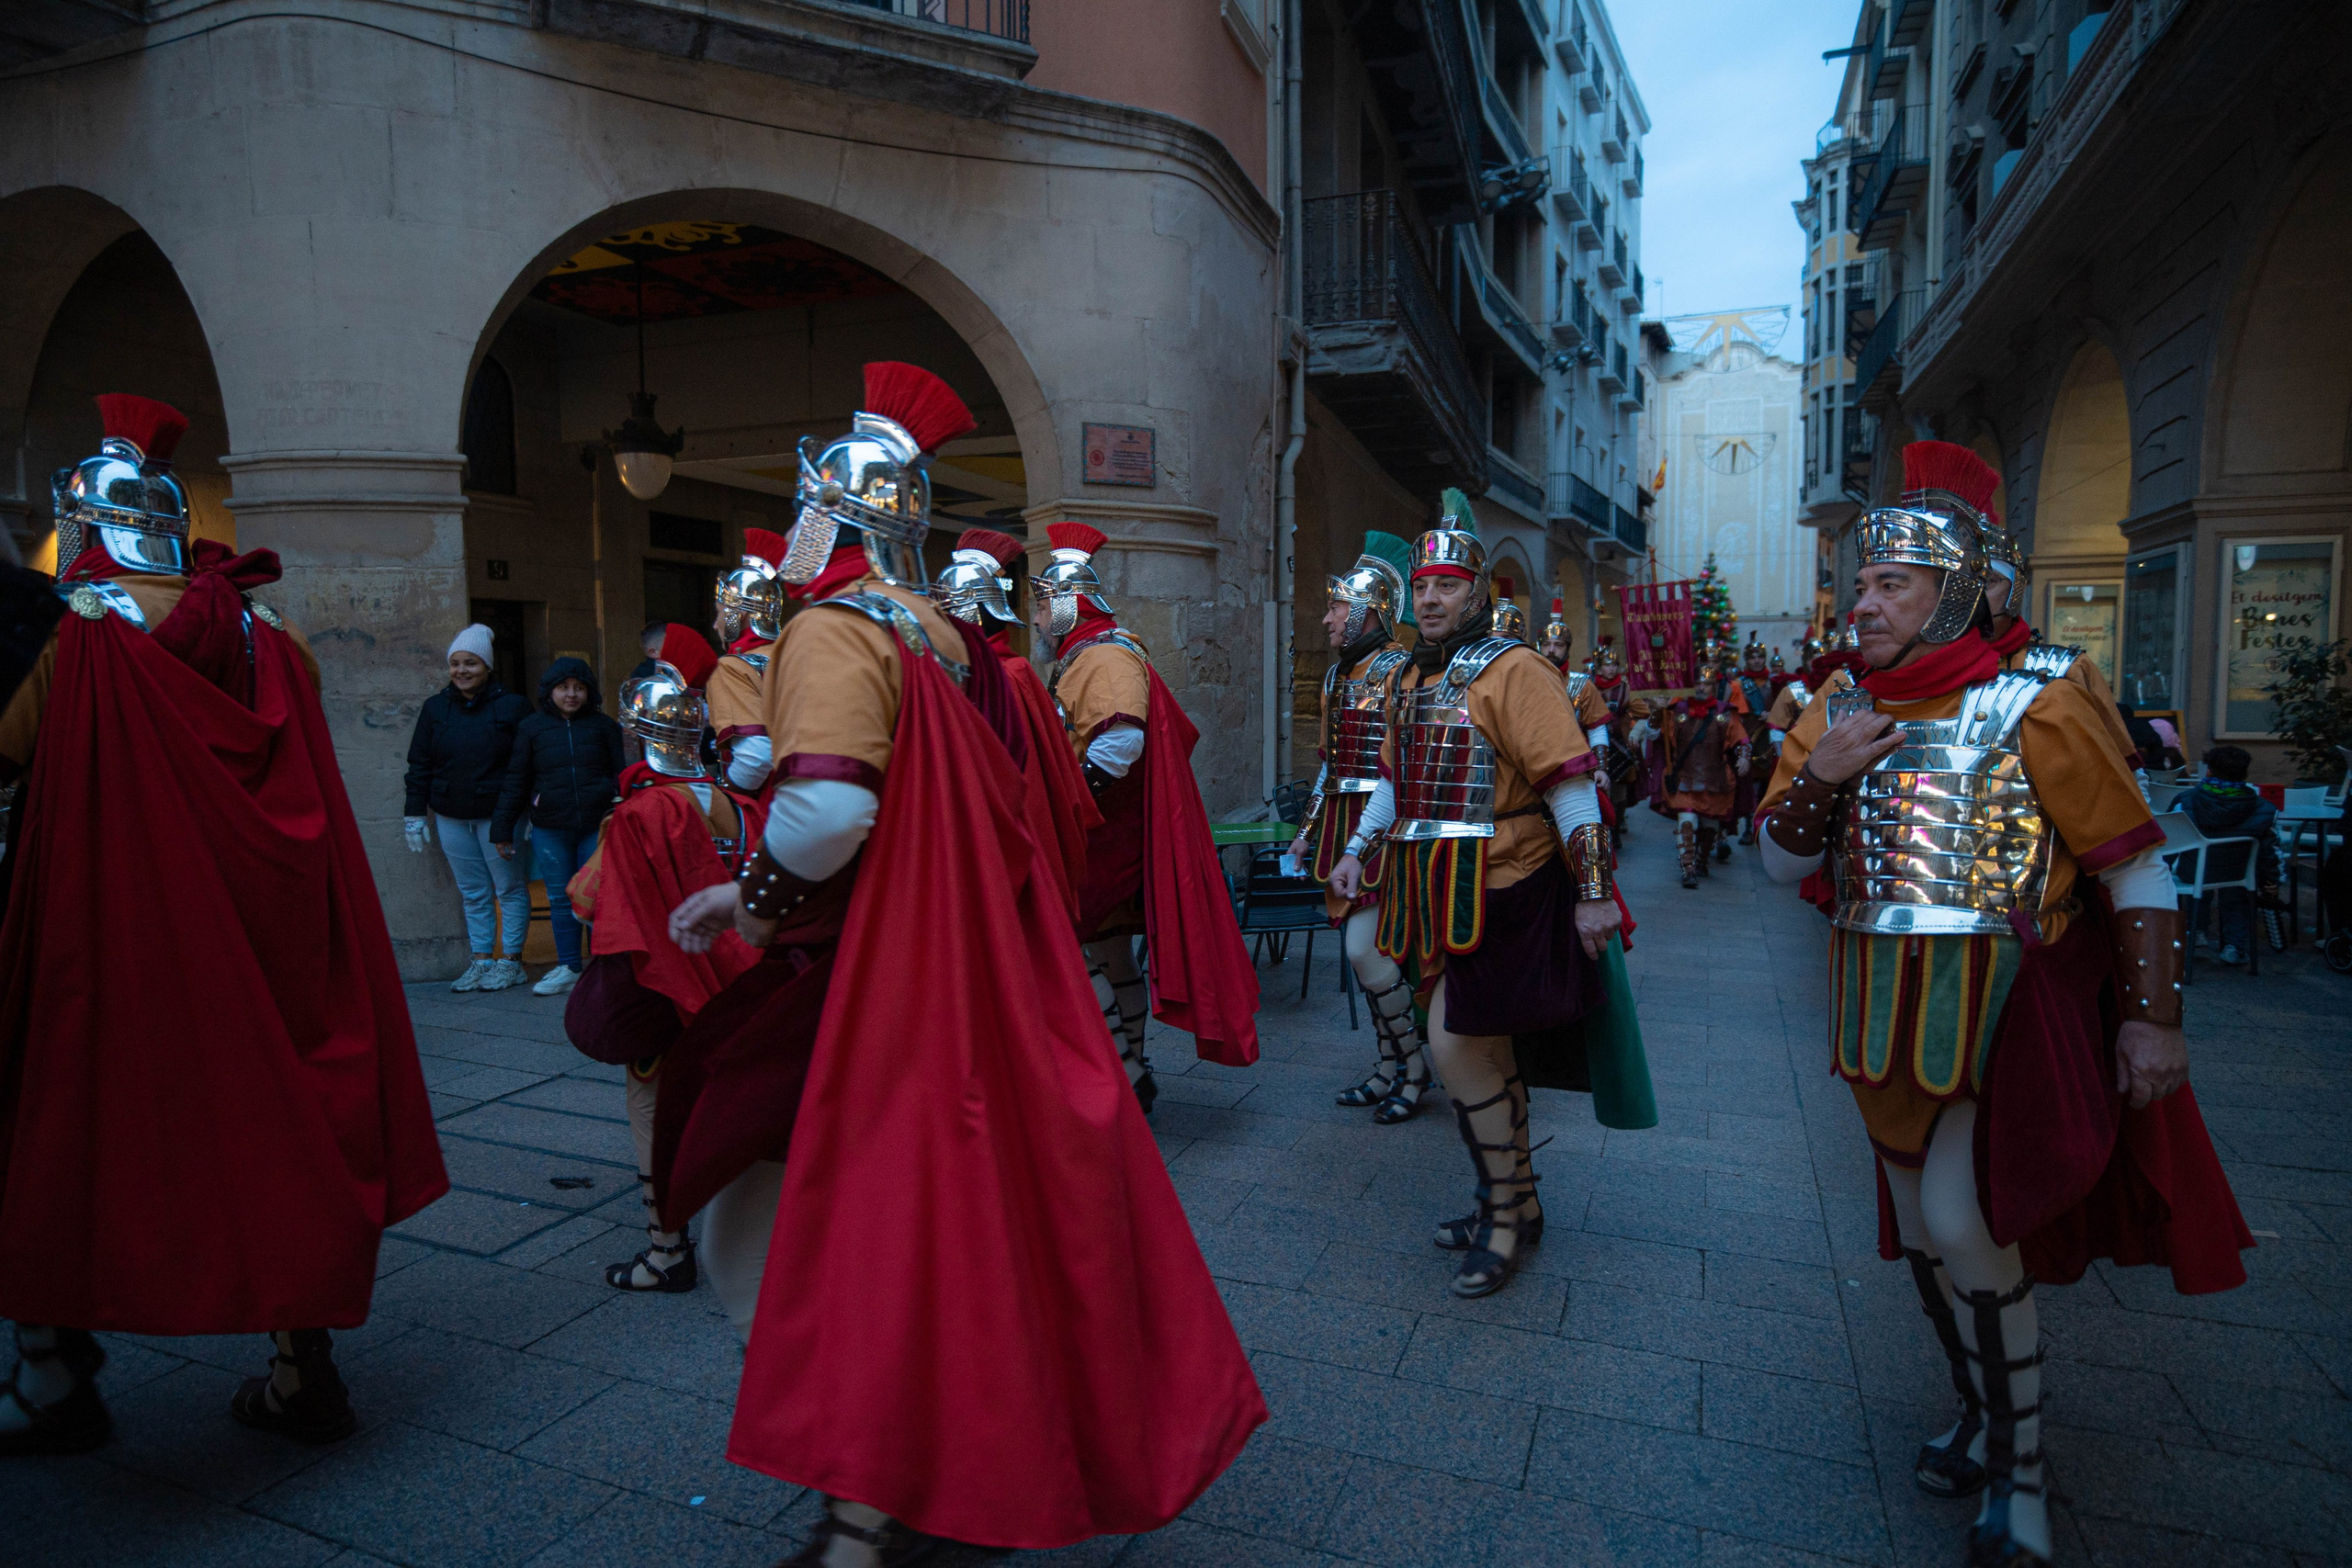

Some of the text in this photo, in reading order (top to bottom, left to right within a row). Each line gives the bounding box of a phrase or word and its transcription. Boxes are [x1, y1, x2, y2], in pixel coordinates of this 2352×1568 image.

[2231, 590, 2324, 606] Et desitgem
[2240, 628, 2312, 650] Festes
